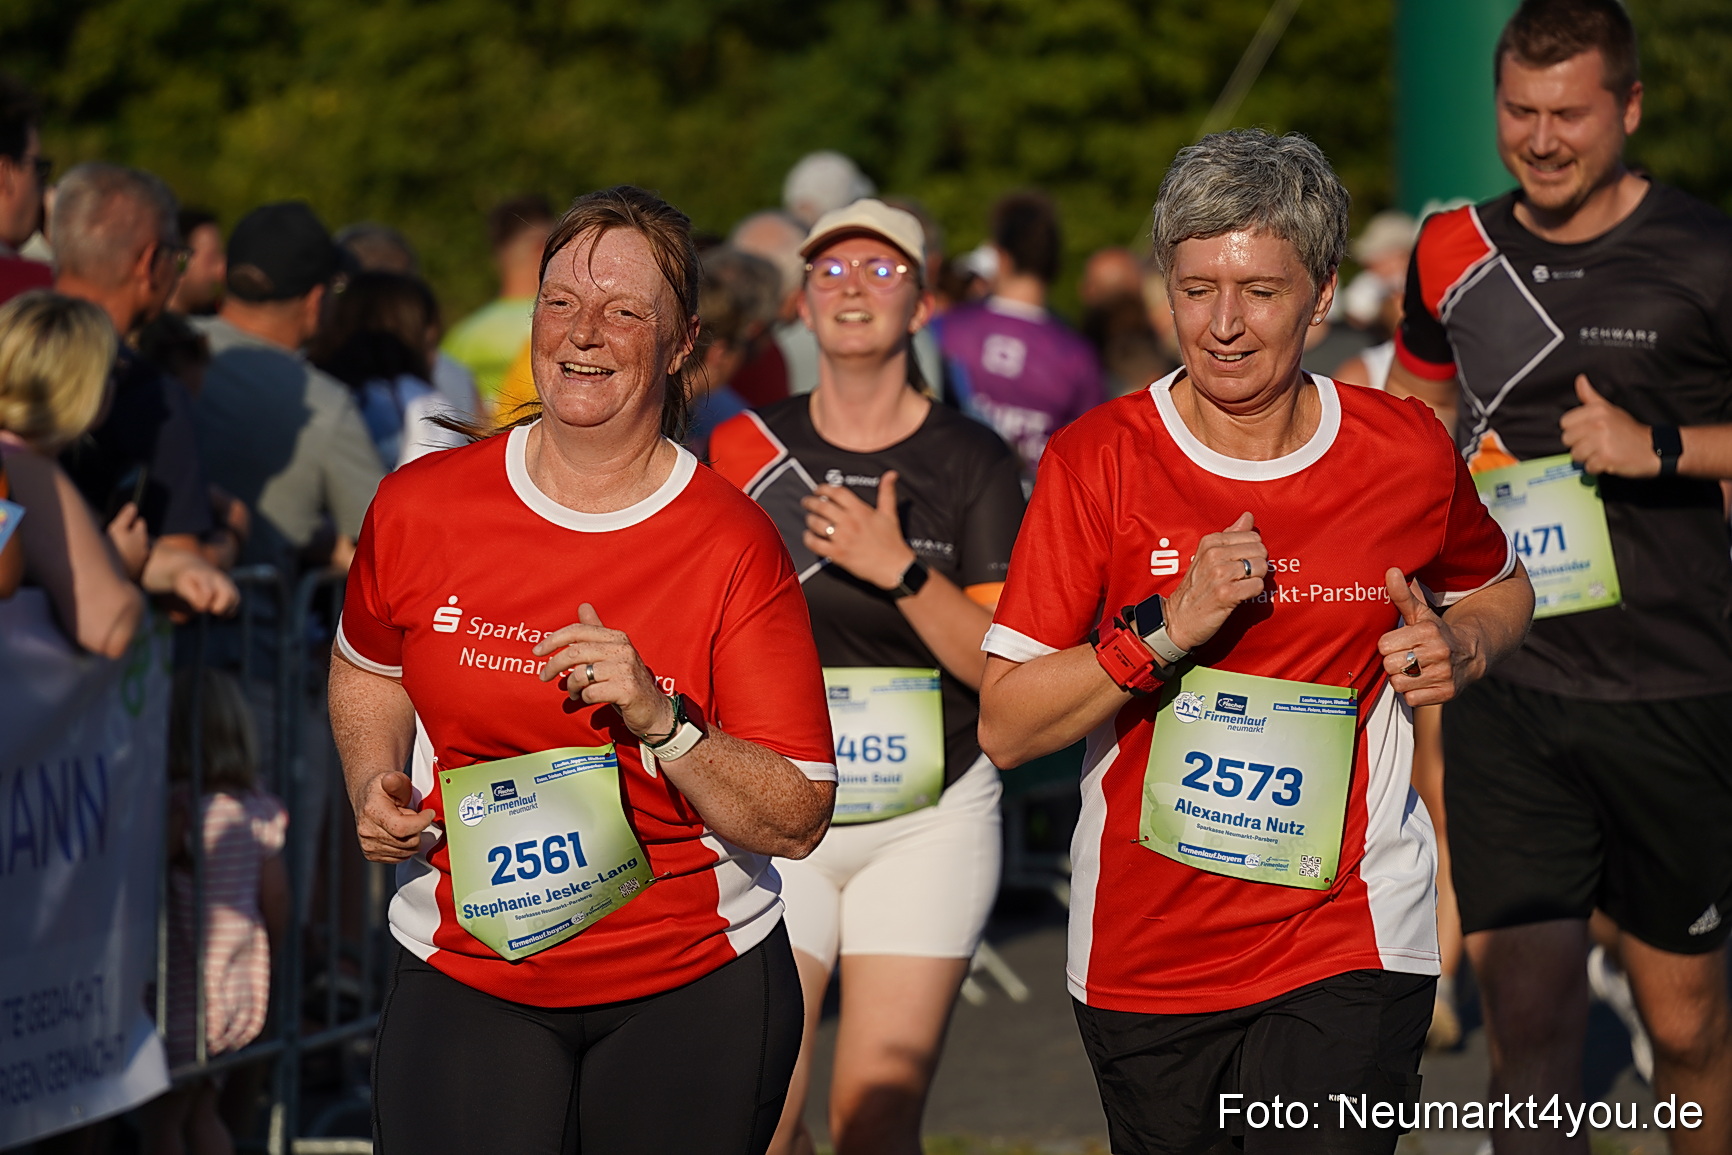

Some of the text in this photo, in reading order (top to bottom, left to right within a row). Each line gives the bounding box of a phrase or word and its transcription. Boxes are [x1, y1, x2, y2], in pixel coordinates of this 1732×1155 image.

[1513, 523, 1566, 557] 471
[1243, 581, 1391, 604] arkt-Parsberg
[1203, 710, 1267, 727] Firmenlauf
[1226, 724, 1264, 734] neumarkt
[836, 735, 906, 763] 465
[1180, 751, 1303, 807] 2573
[0, 755, 107, 875] ANN
[487, 791, 537, 815] Firmenlauf
[508, 803, 539, 817] neumarkt
[1174, 798, 1306, 836] Alexandra Nutz
[1196, 823, 1279, 844] Sparkasse Neumarkt-Parsberg
[487, 831, 589, 886] 2561
[1180, 845, 1243, 863] firmenlauf.bayern
[463, 857, 639, 919] Stephanie Jeske-Lang
[514, 911, 542, 921] Sparkasse
[541, 893, 593, 915] Neumarkt-Parsberg
[511, 922, 570, 949] firmenlauf.bayern
